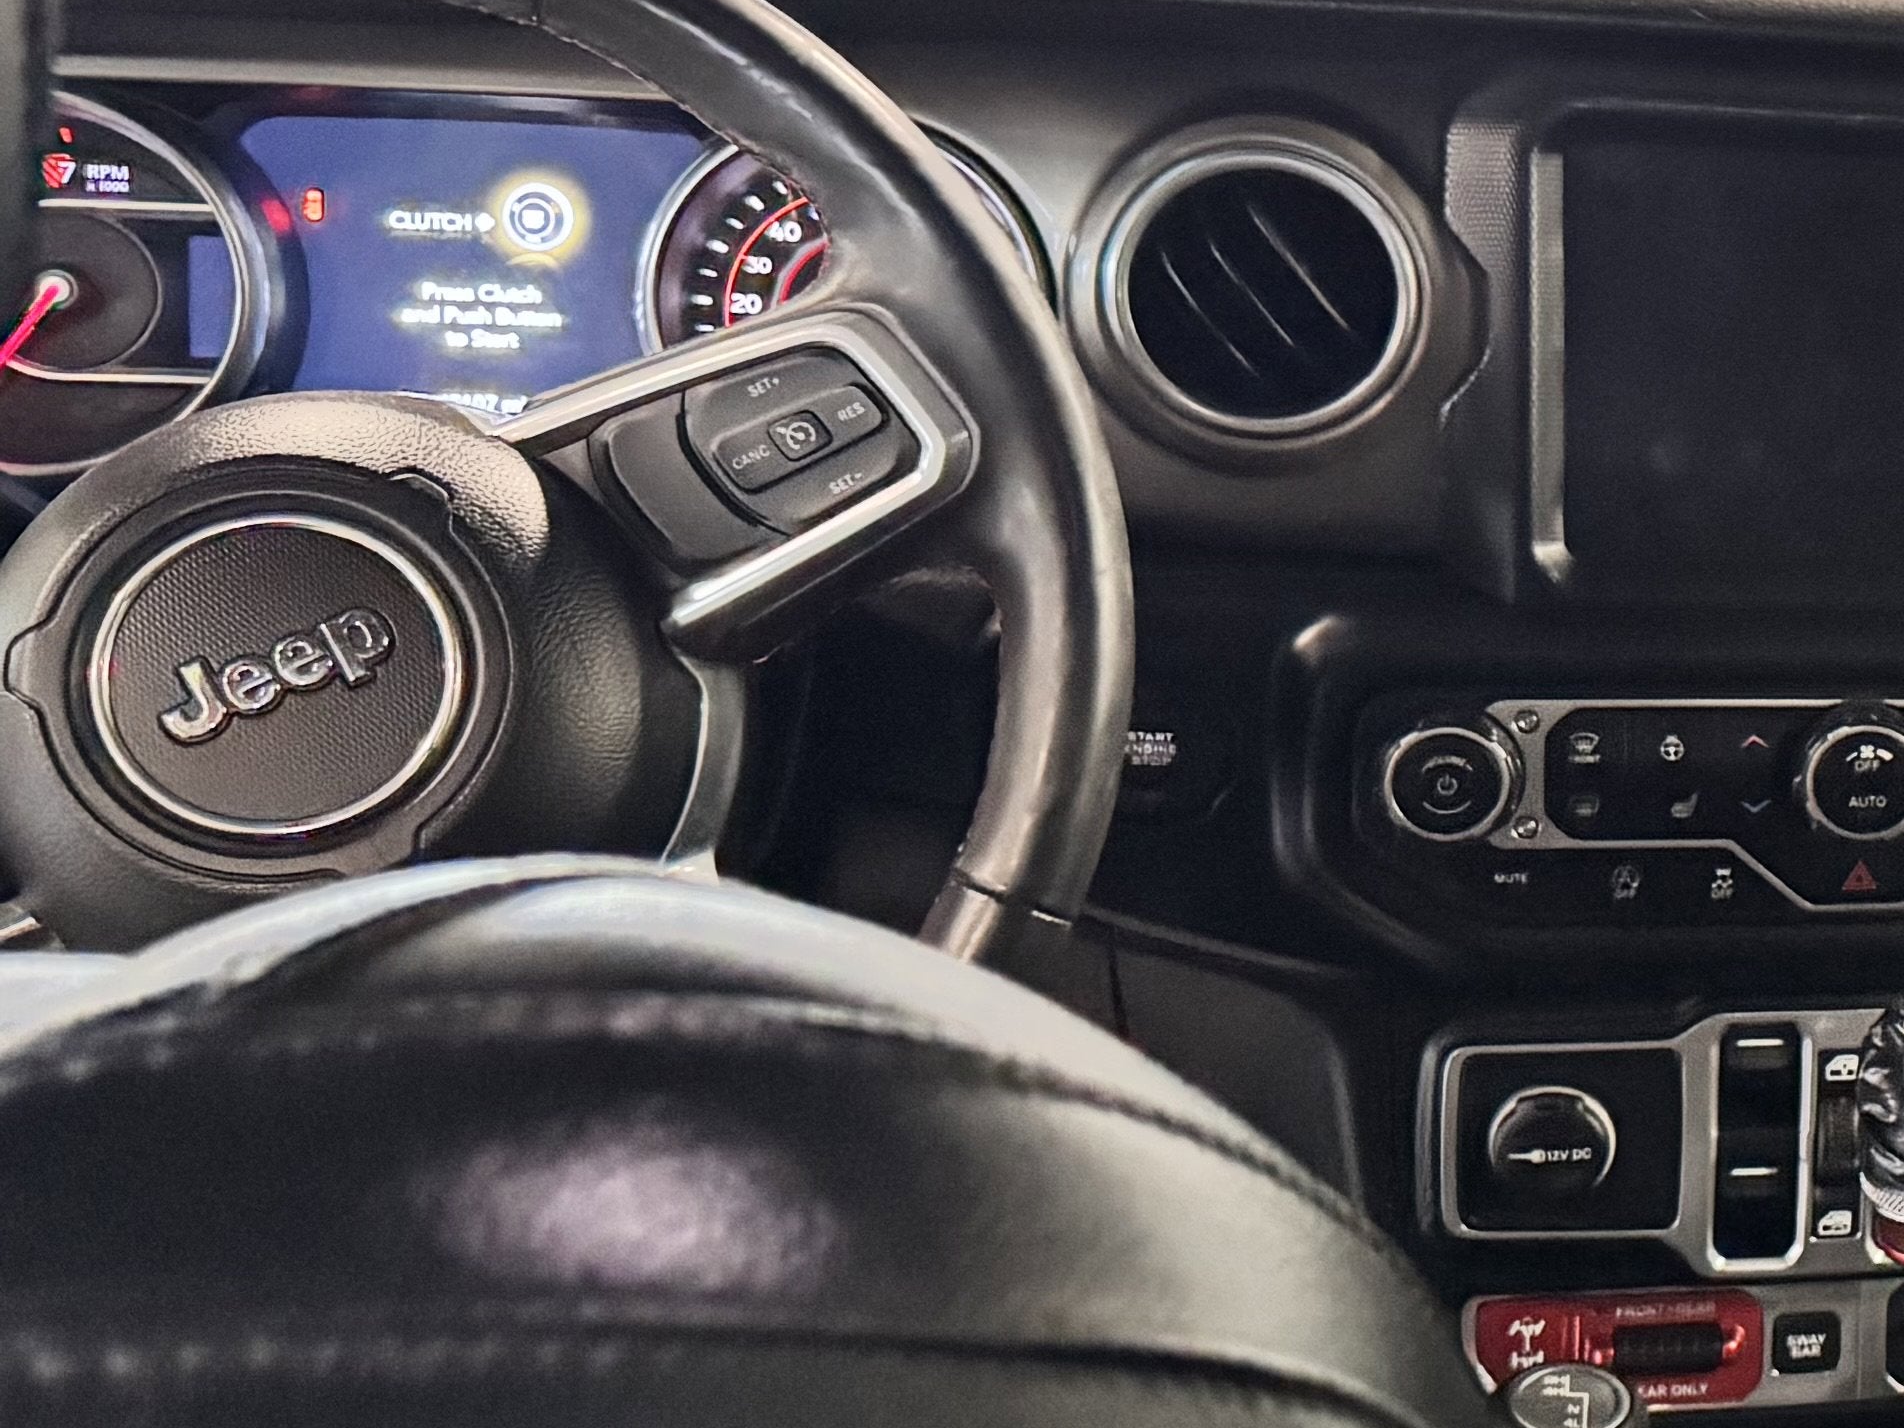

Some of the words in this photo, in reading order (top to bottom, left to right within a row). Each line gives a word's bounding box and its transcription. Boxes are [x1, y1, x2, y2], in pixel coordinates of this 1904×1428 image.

[86, 163, 130, 181] RPM
[389, 210, 472, 232] CLUTCH
[766, 221, 803, 243] 40
[742, 256, 773, 275] 30
[421, 281, 475, 302] Press
[478, 283, 543, 304] Clutch
[730, 293, 763, 315] 20
[401, 305, 441, 324] and
[444, 305, 493, 326] Push
[495, 306, 563, 328] Button
[445, 330, 469, 348] to
[471, 328, 520, 349] Start
[747, 378, 779, 398] SET+
[837, 401, 867, 423] RES
[732, 444, 771, 471] CANC
[159, 607, 397, 744] Jeep
[1854, 759, 1880, 772] OFF
[1849, 795, 1887, 808] AUTO
[1494, 874, 1528, 884] MUTE
[1546, 1149, 1569, 1162] 12V
[1571, 1148, 1592, 1161] DC
[1670, 1382, 1709, 1397] ONLY
[1567, 1403, 1580, 1414] N
[1563, 1418, 1580, 1428] 4L
